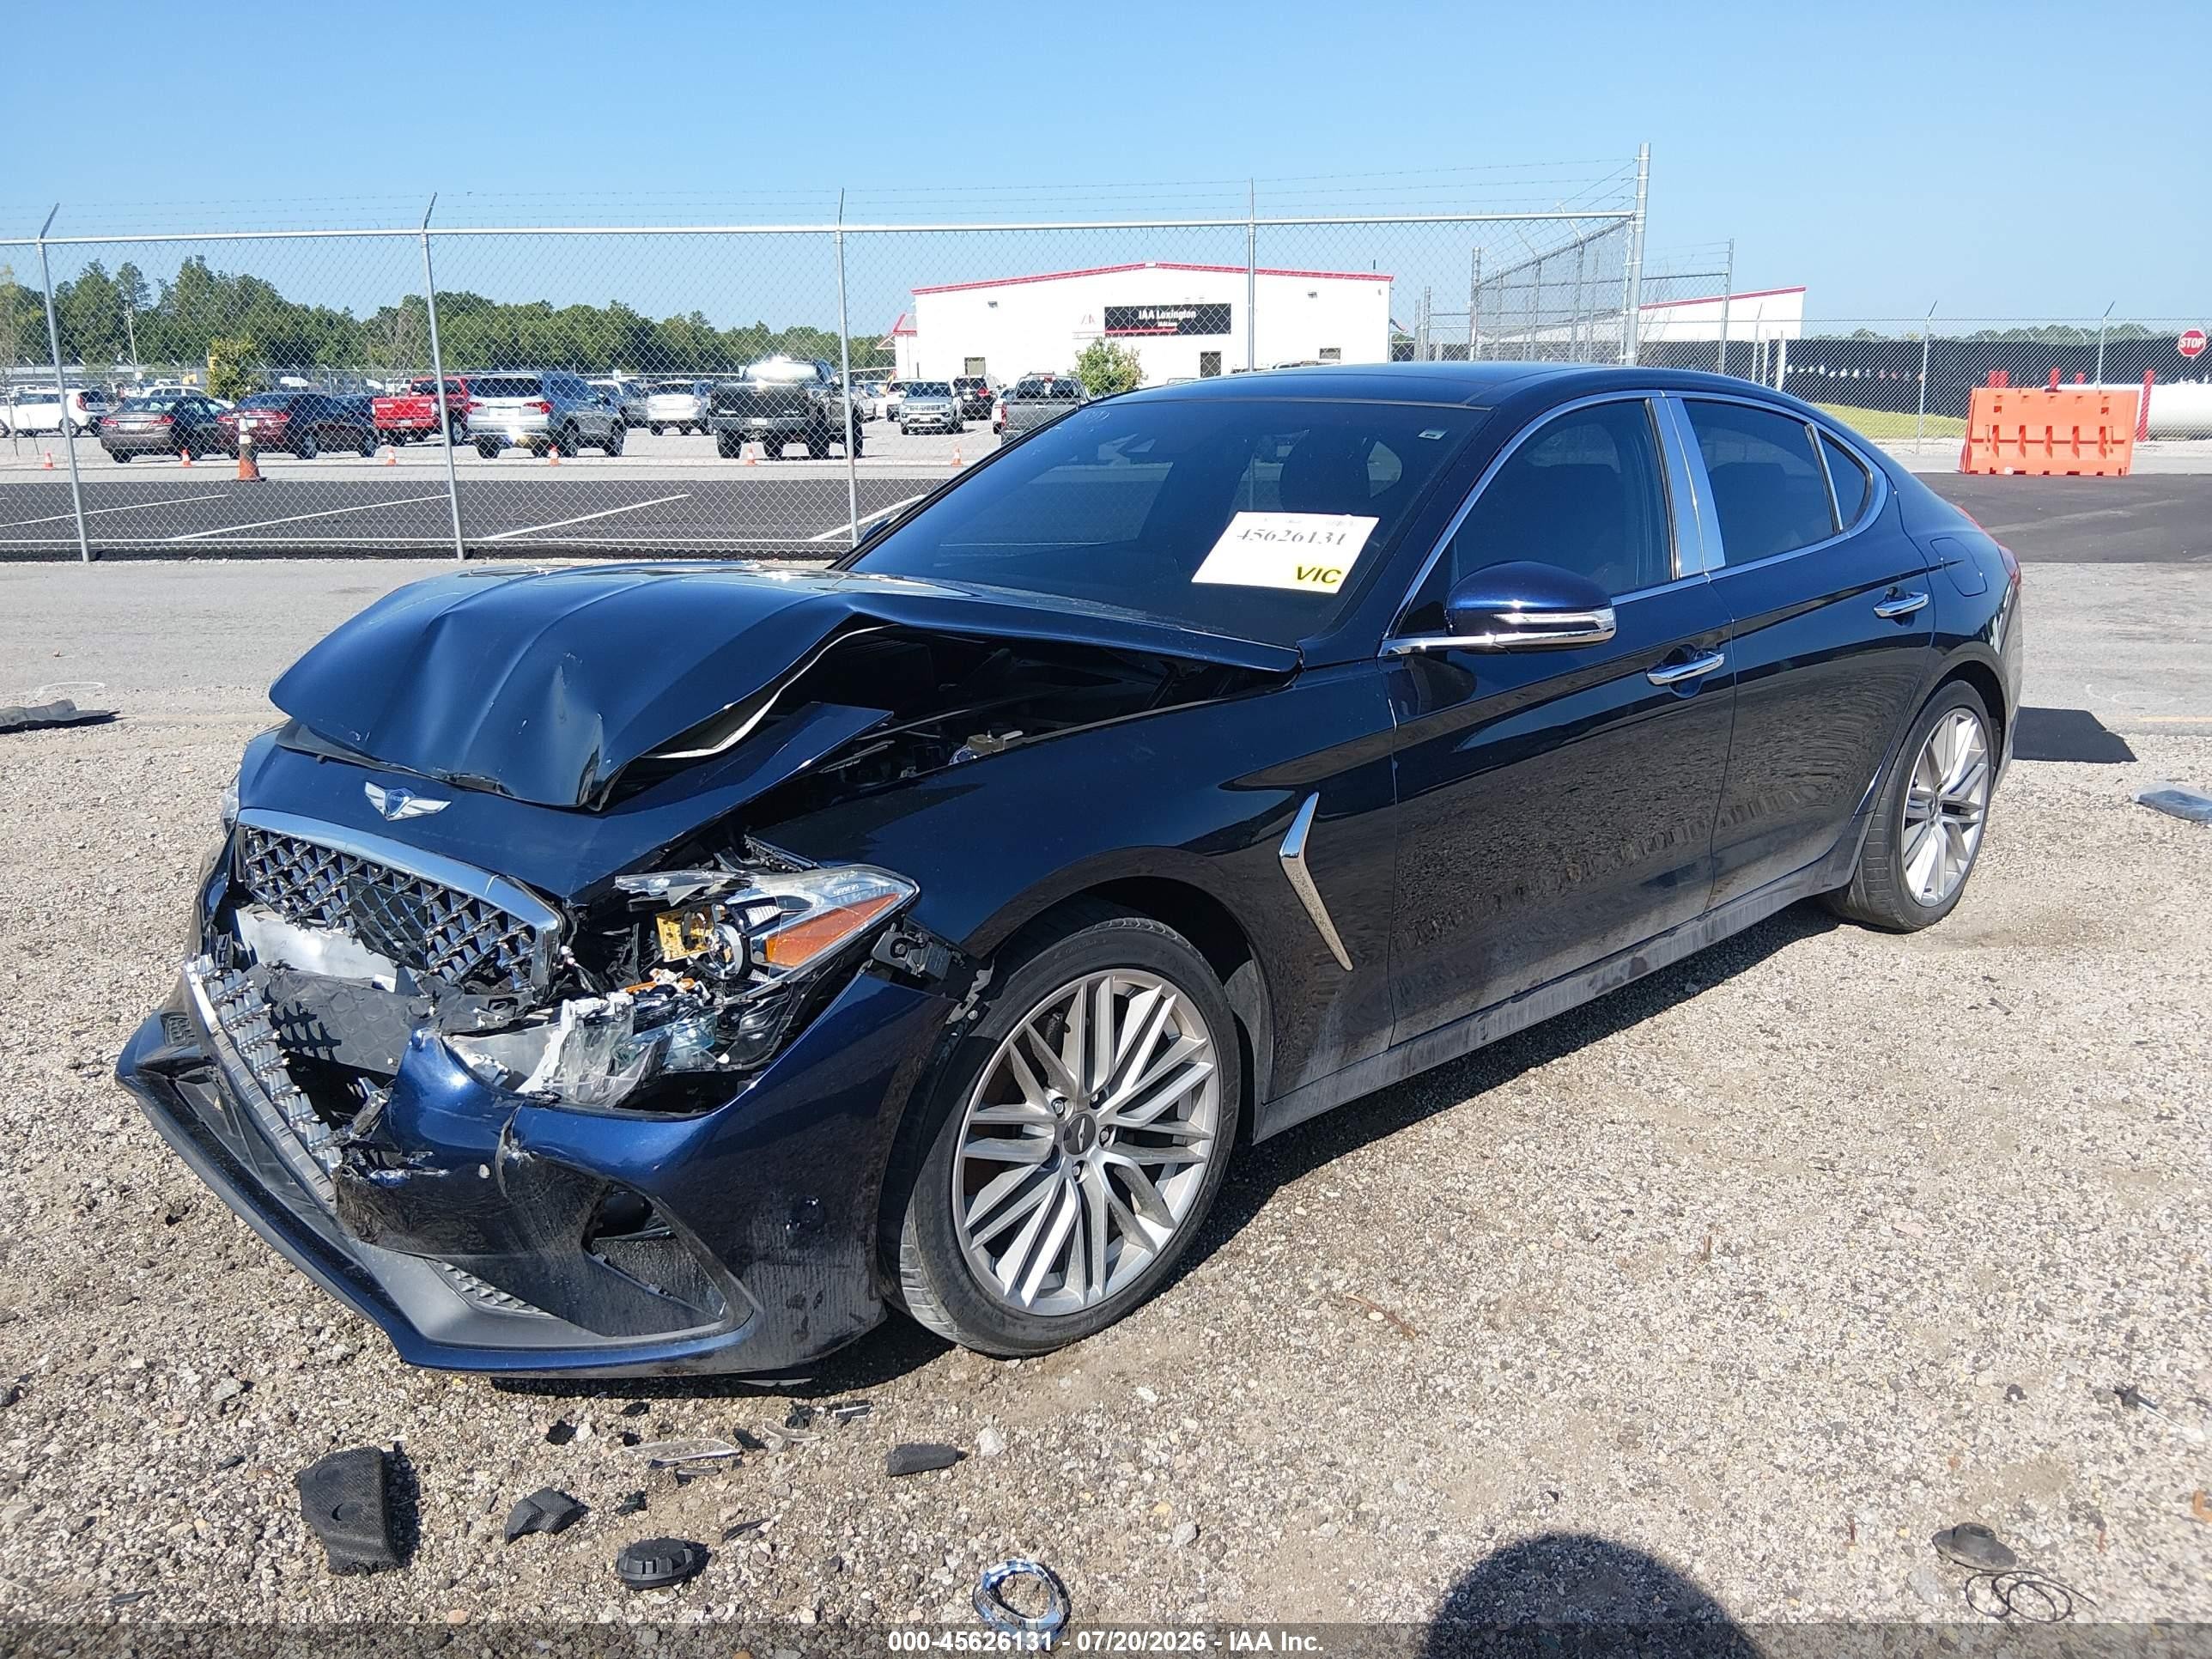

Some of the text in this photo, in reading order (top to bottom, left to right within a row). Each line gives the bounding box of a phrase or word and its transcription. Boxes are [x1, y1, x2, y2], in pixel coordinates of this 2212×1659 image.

[1139, 309, 1196, 320] IAA Lexington
[2180, 337, 2204, 349] STOP
[1237, 528, 1347, 545] 45626131
[1296, 566, 1342, 584] VIC
